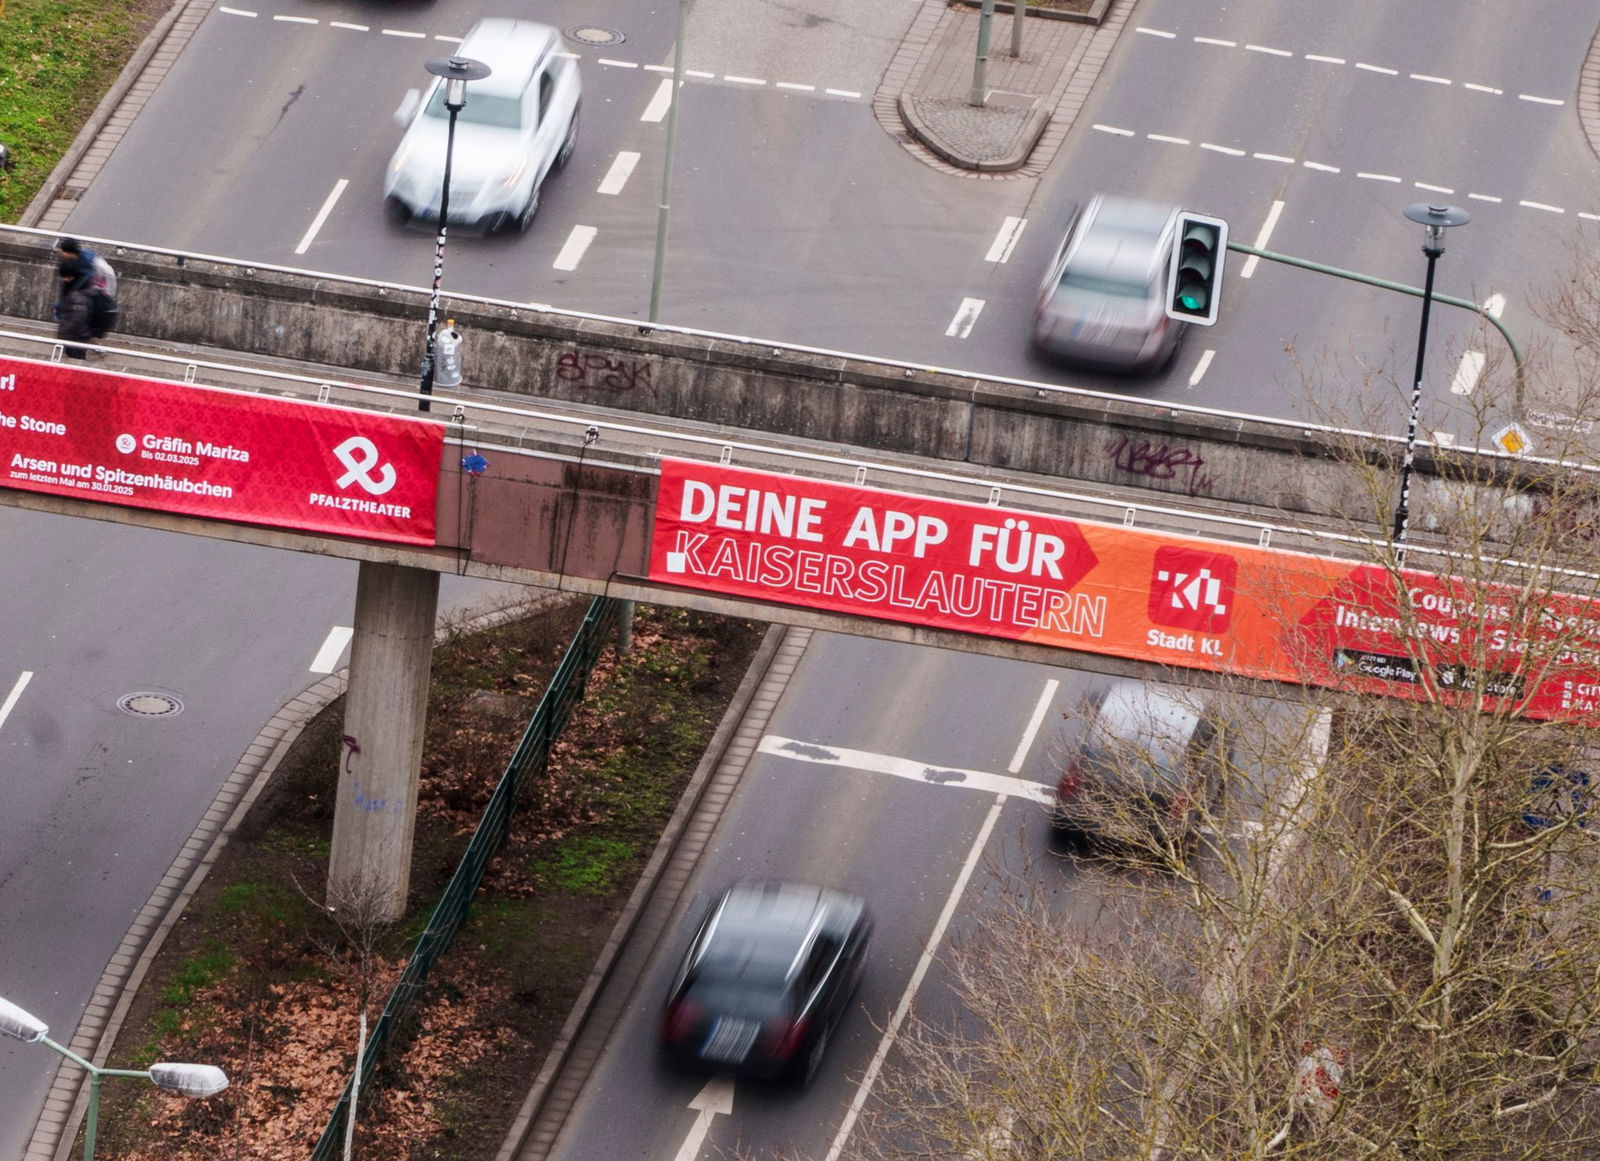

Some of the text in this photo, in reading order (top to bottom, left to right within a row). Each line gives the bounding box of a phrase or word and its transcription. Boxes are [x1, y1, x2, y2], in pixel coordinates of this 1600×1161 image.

[20, 415, 66, 436] Stone
[141, 451, 200, 466] Bis 02.03.2025
[142, 434, 250, 463] Gräfin Mariza
[10, 471, 134, 496] zum letzten Mal am 30.01.2025
[11, 453, 233, 498] Arsen und Spitzenhäubchen
[309, 493, 411, 519] PFALZTHEATER
[680, 479, 1066, 580] DEINE APP FÜR
[674, 530, 1107, 637] KAISERSLAUTERN
[1147, 629, 1224, 656] Stadt KL
[1358, 662, 1417, 681] Google Play
